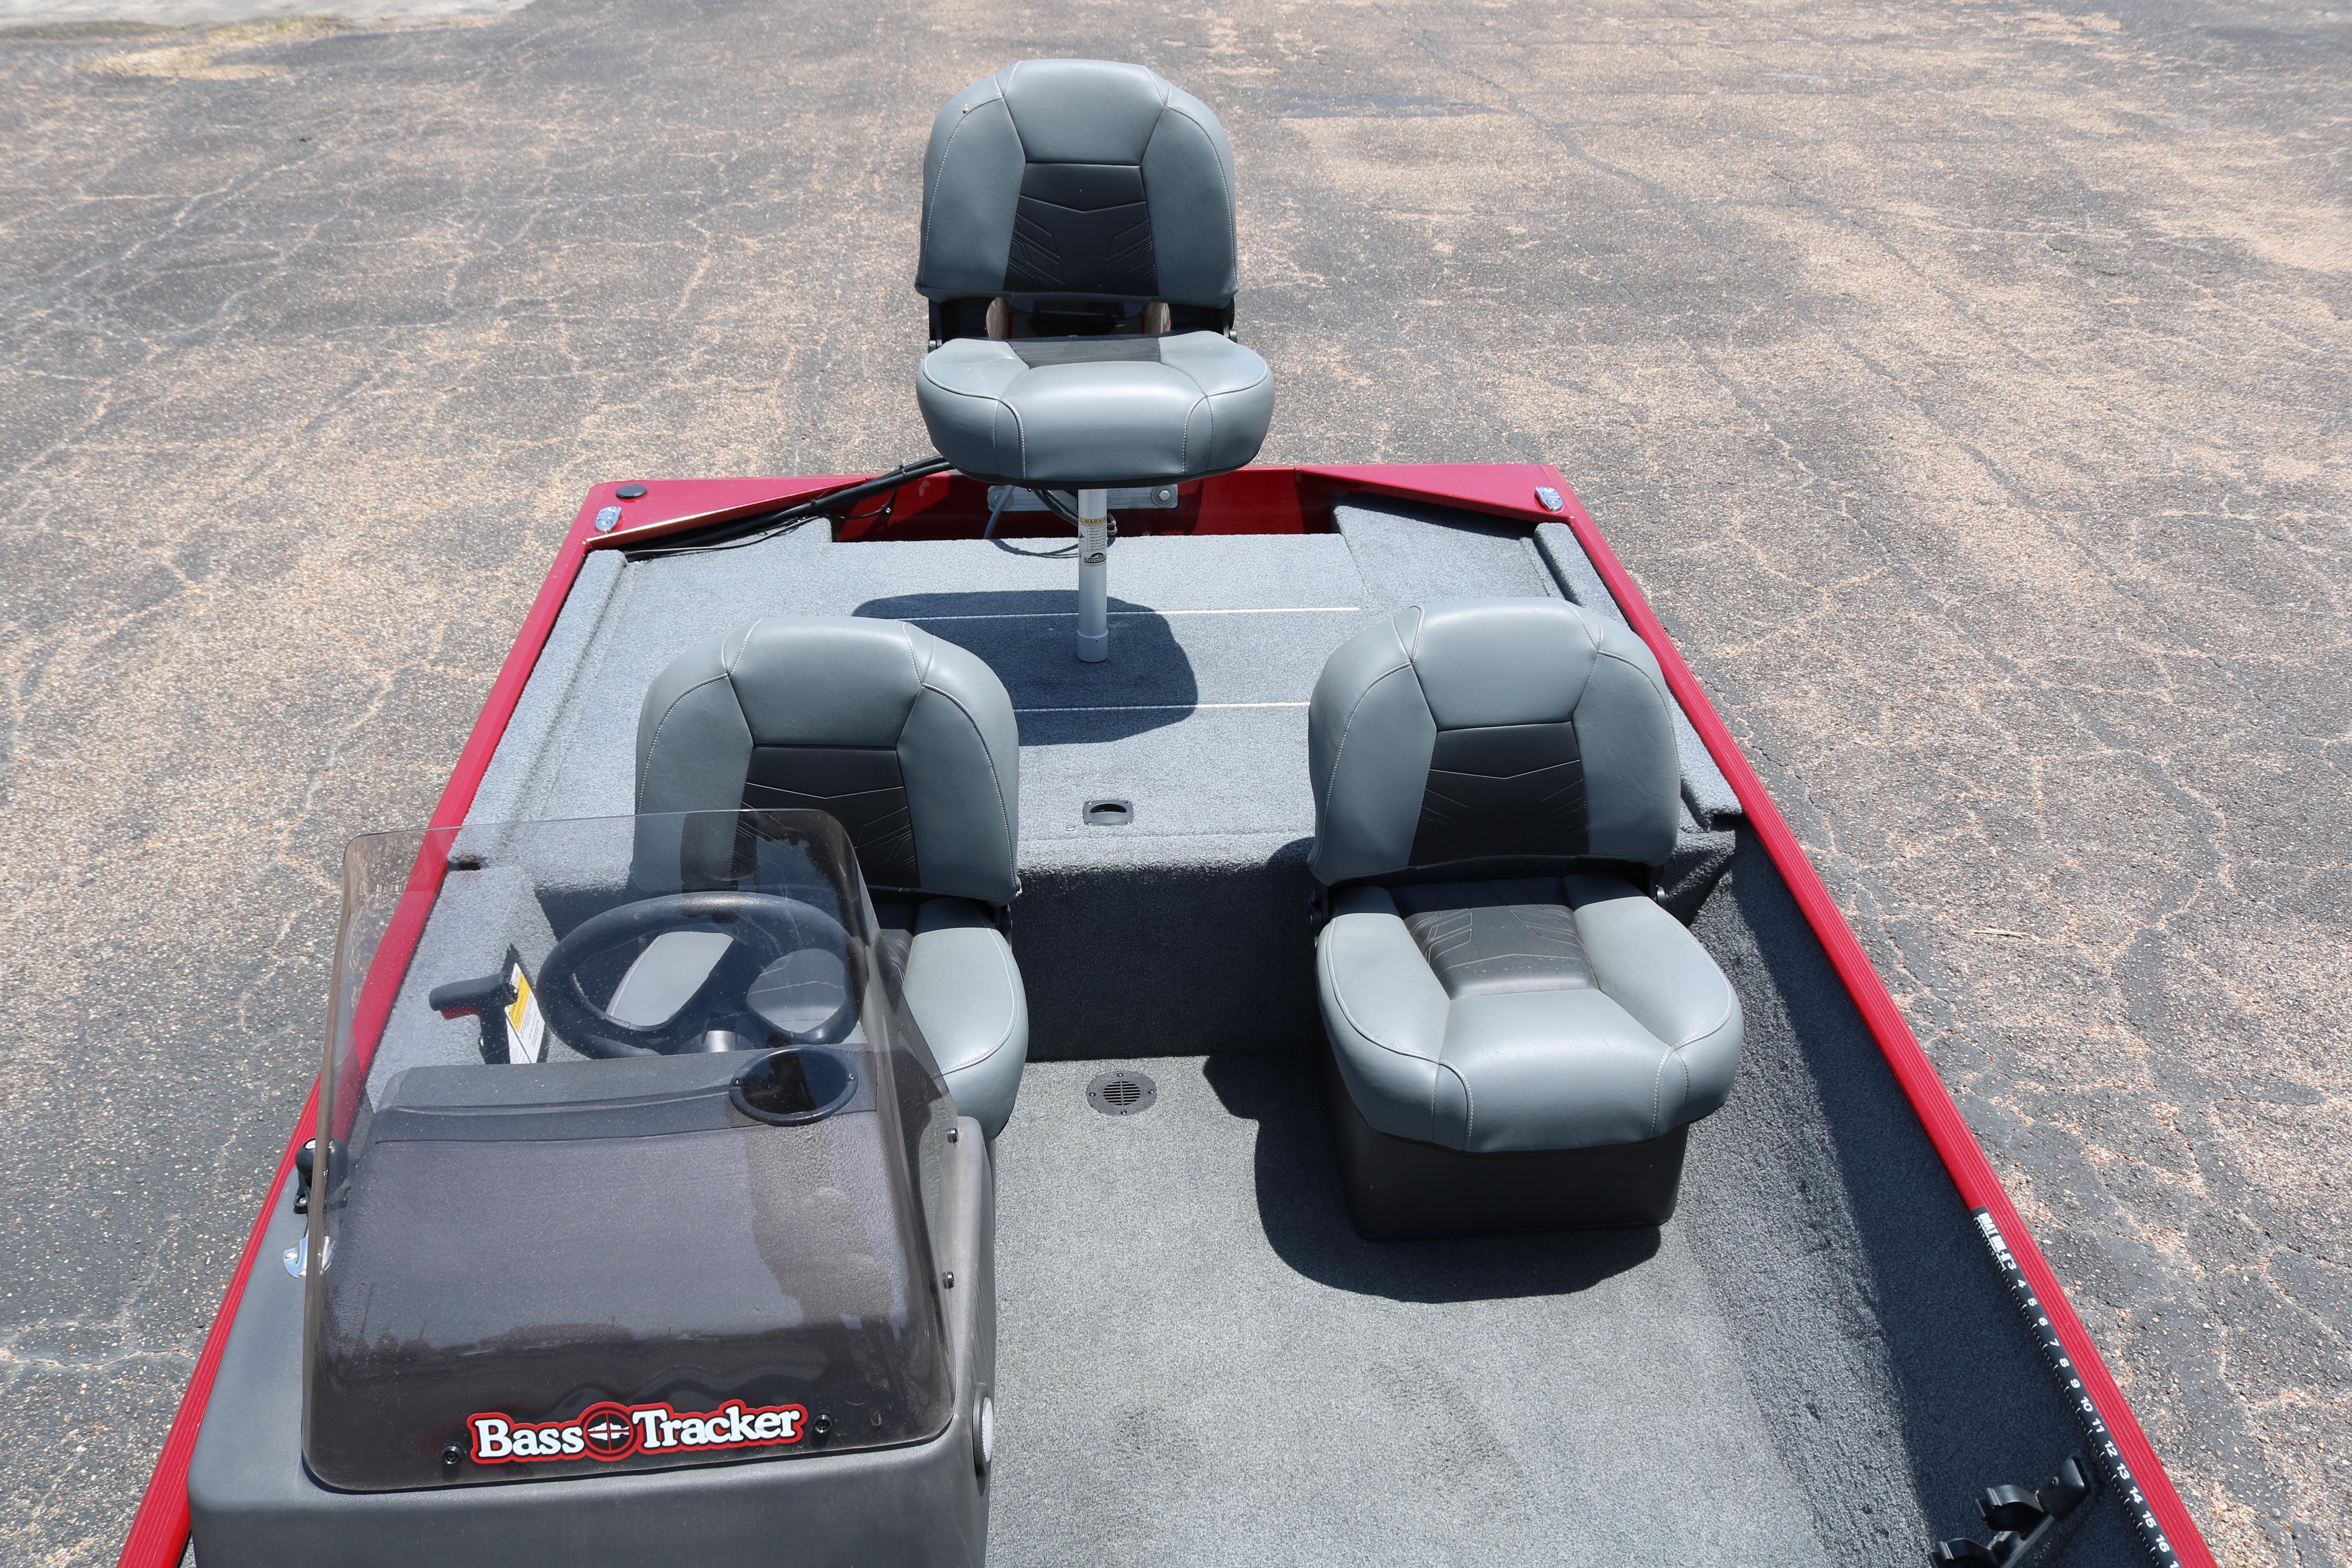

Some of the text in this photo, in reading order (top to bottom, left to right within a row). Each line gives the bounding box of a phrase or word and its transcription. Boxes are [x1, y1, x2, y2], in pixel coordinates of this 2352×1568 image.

[1979, 1212, 1998, 1235] BOAT
[474, 1405, 800, 1458] Bass Tracker
[2007, 1261, 2017, 1270] 3
[2017, 1279, 2027, 1288] 4
[2027, 1298, 2038, 1307] 5
[2039, 1317, 2048, 1327] 6
[2049, 1338, 2060, 1346] 7
[2059, 1358, 2069, 1368] 8
[2070, 1379, 2080, 1389] 9
[2080, 1396, 2093, 1412] 10
[2092, 1418, 2105, 1433] 11
[2104, 1440, 2118, 1458] 12
[2117, 1462, 2130, 1480] 13
[2129, 1486, 2143, 1504] 14
[2142, 1511, 2157, 1528] 15
[2156, 1534, 2170, 1552] 16
